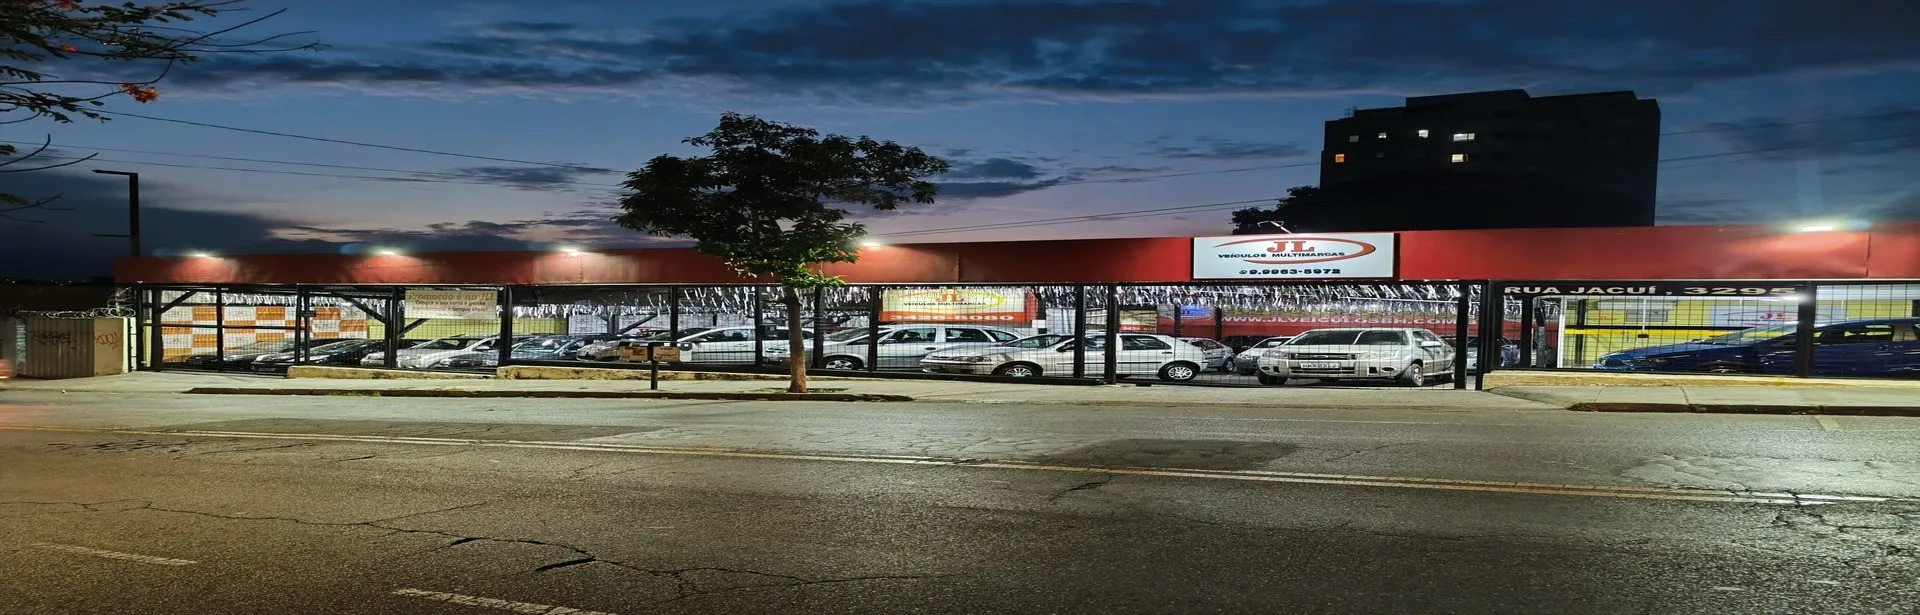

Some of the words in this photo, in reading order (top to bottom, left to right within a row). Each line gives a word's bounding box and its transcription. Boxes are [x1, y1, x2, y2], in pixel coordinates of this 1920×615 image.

[1267, 241, 1315, 253] JL
[1569, 286, 1656, 294] JACUÍ
[1683, 287, 1796, 295] 3295
[935, 293, 965, 302] JL
